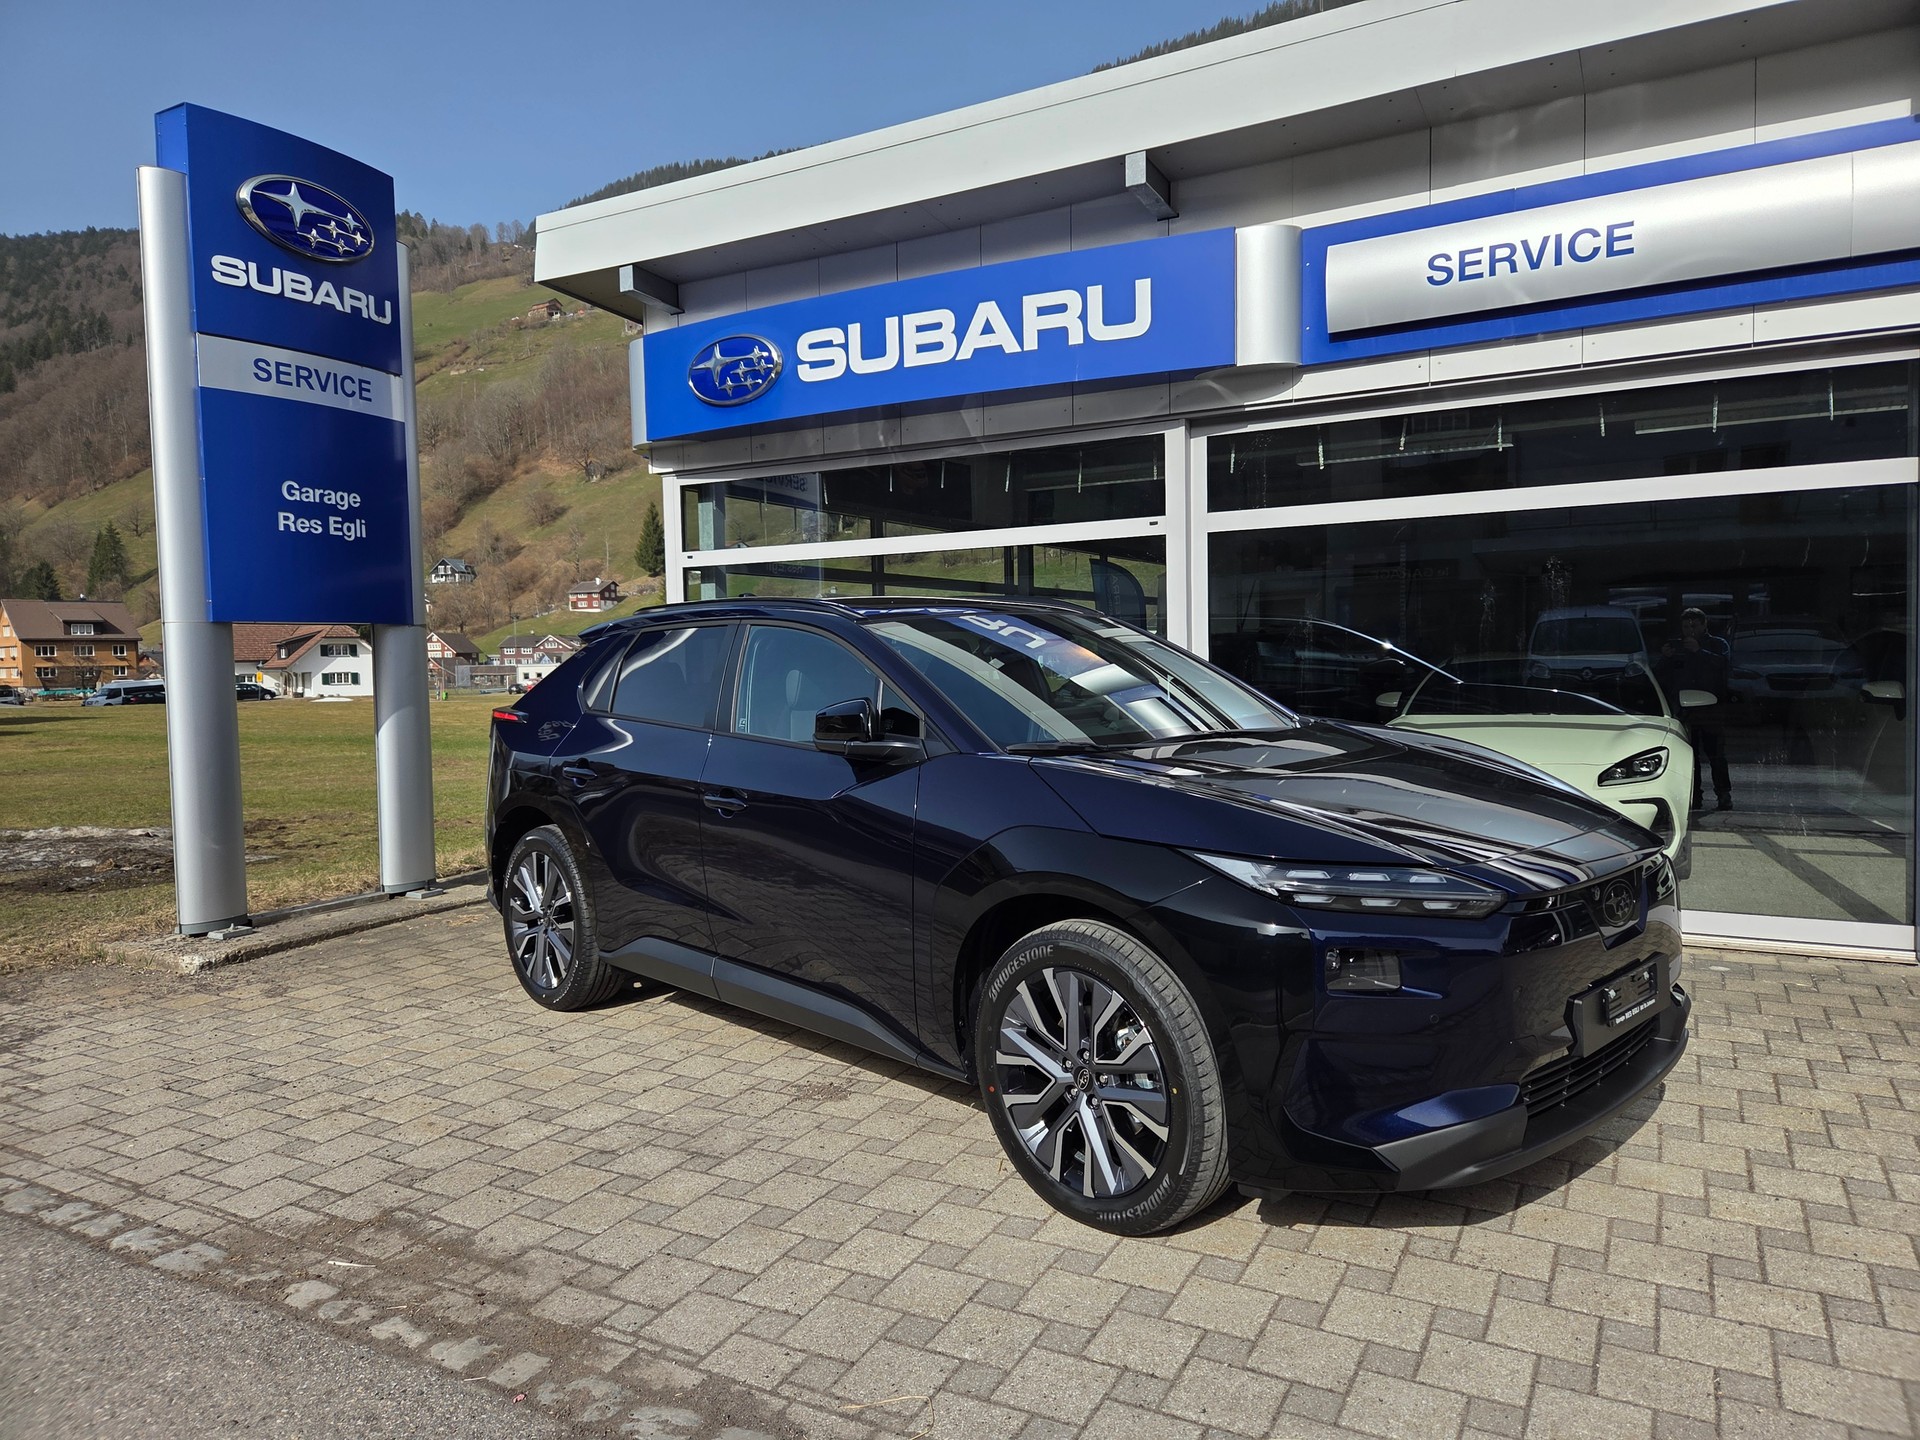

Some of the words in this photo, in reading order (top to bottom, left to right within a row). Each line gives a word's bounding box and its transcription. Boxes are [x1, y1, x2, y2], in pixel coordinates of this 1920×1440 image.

[1427, 220, 1634, 287] SERVICE
[210, 254, 392, 325] SUBARU
[796, 278, 1152, 382] SUBARU
[252, 357, 373, 402] SERVICE
[281, 480, 361, 510] Garage
[278, 511, 323, 534] Res
[329, 516, 367, 542] Egli
[988, 944, 1054, 1002] BRIDGESTONE
[1096, 1172, 1176, 1223] BRIDGESTONE
